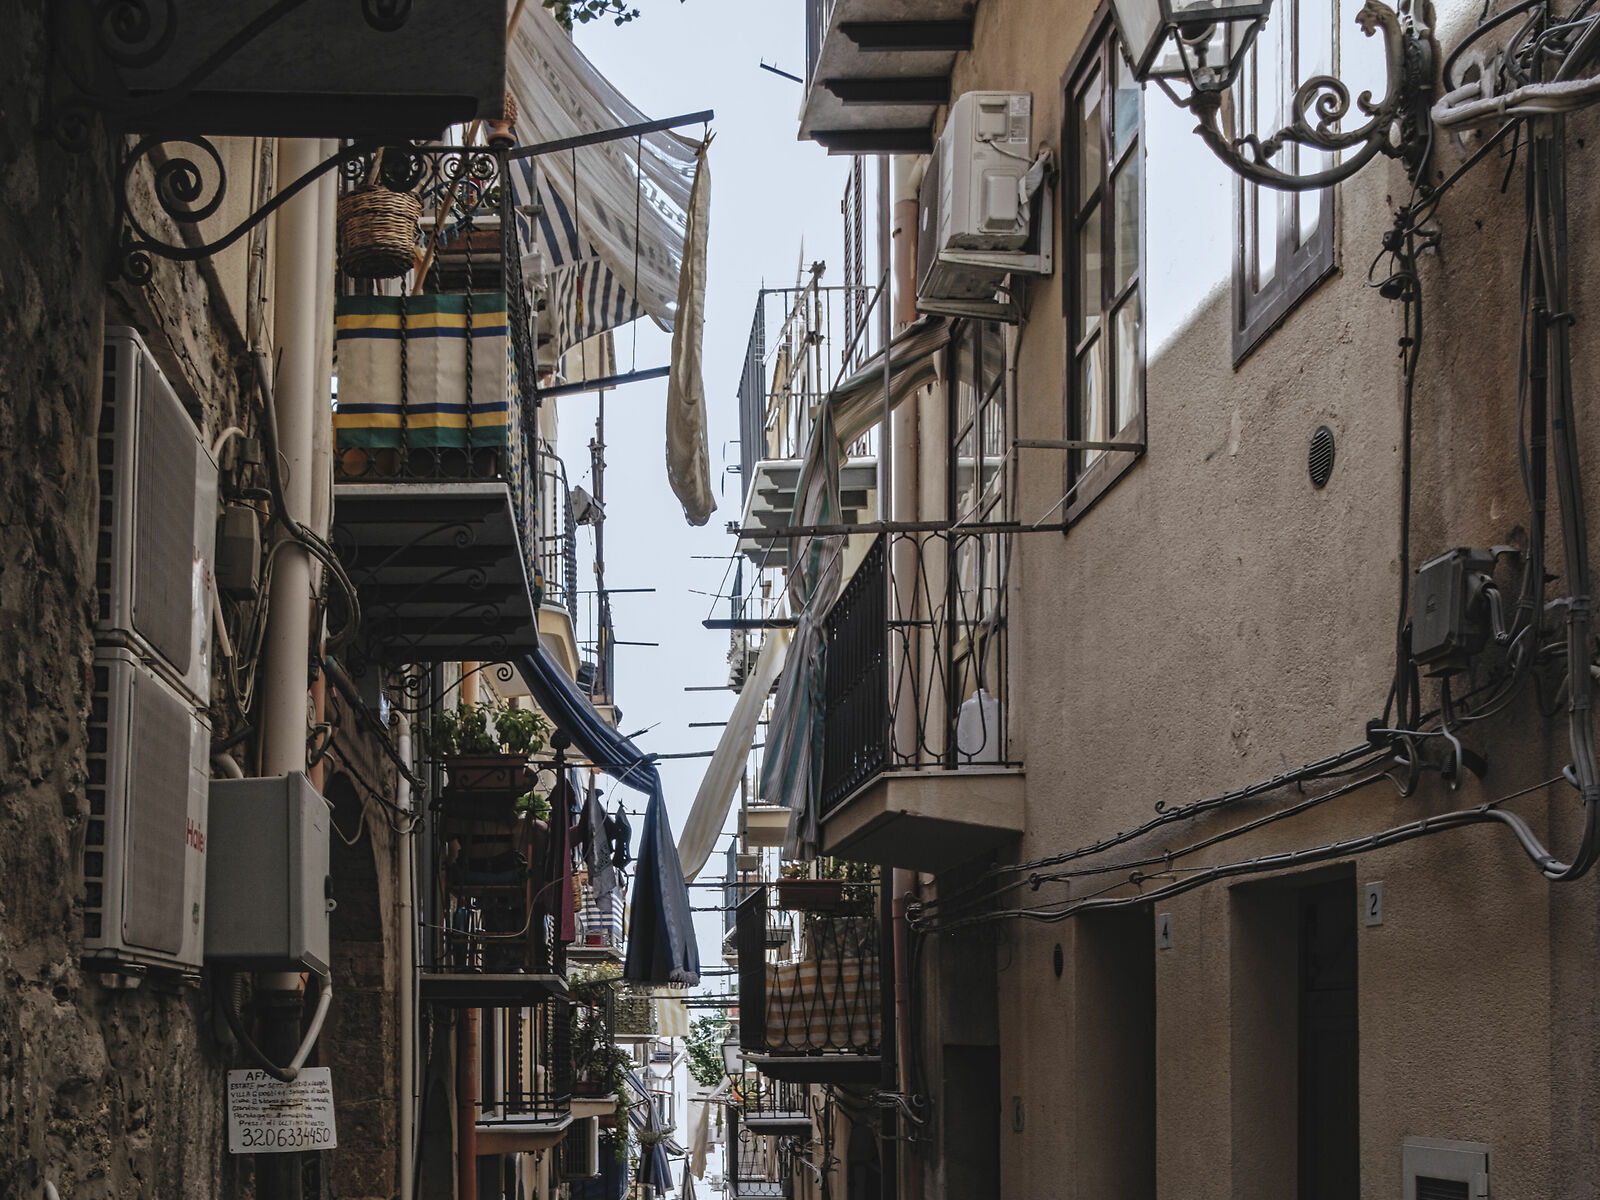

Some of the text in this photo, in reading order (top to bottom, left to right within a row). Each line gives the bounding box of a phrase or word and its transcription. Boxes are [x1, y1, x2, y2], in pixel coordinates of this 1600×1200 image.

[1370, 893, 1377, 916] 2
[1162, 920, 1169, 939] 4
[243, 1128, 331, 1147] 3206334450
